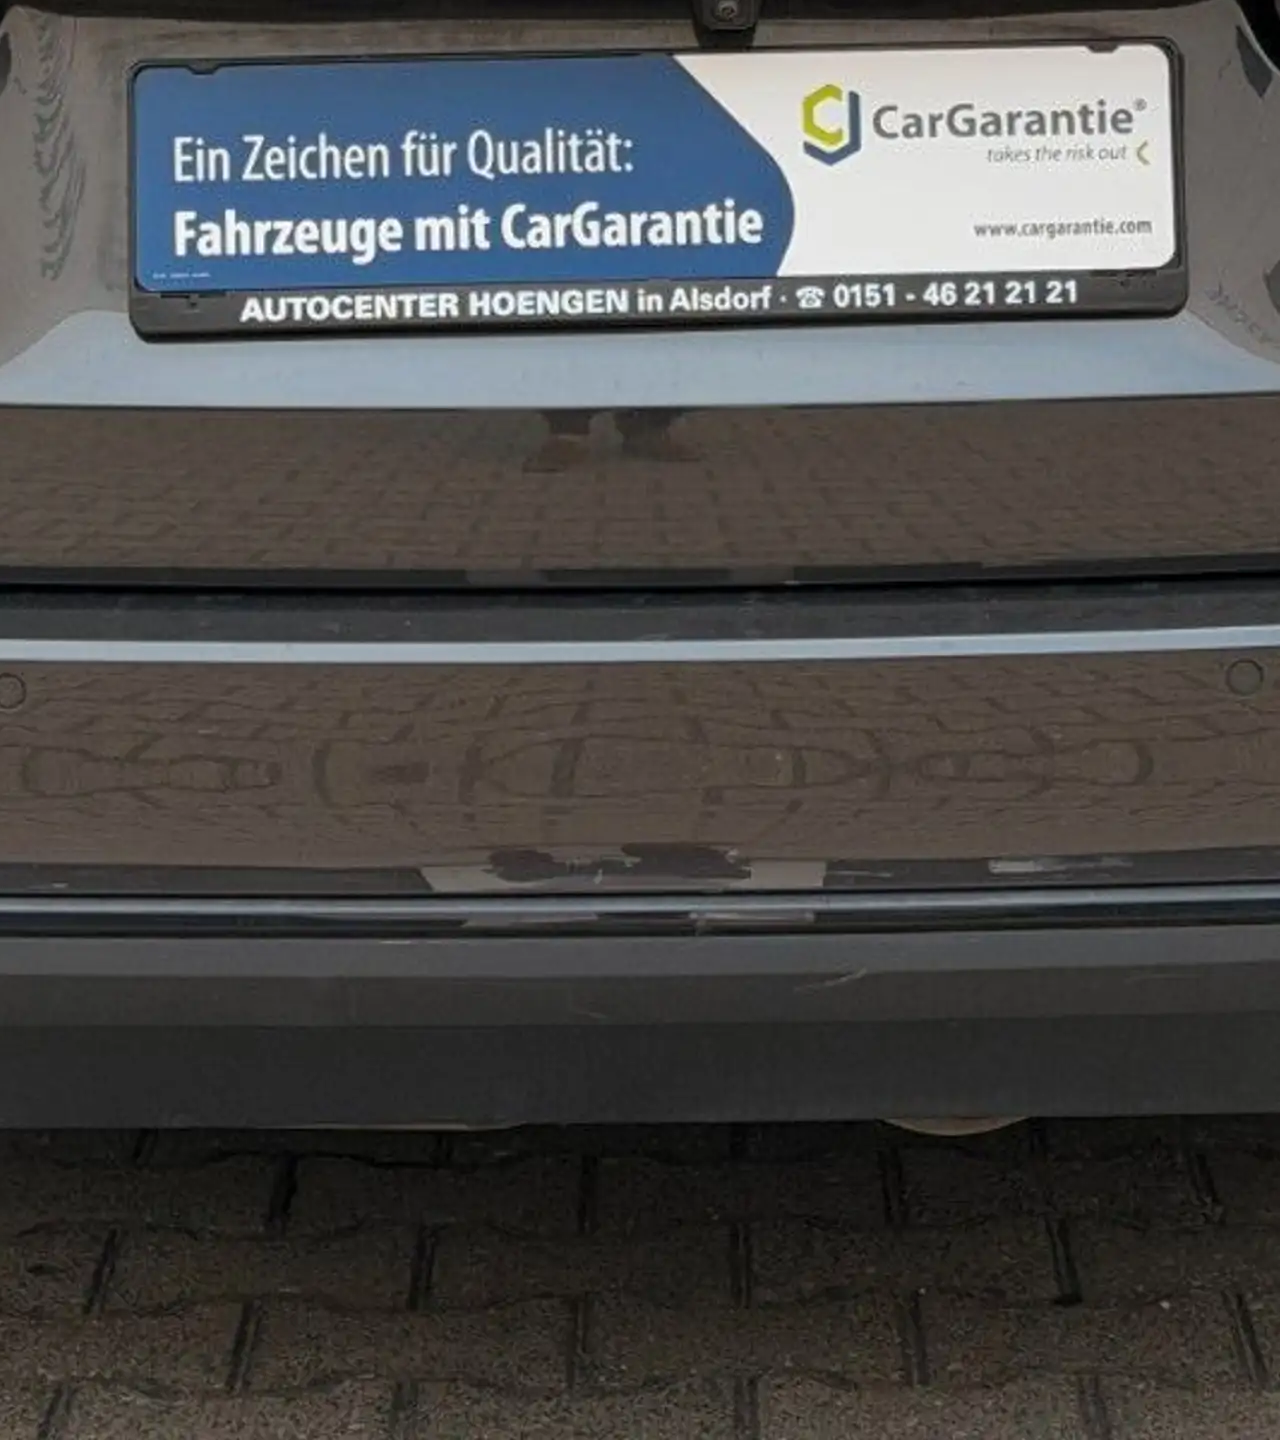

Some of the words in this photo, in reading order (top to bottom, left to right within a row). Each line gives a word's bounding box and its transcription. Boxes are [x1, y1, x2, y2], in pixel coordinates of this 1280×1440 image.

[174, 135, 231, 183] Ein
[242, 131, 390, 181] Zeichen
[401, 129, 457, 177] für
[467, 127, 634, 180] Qualität:
[987, 146, 1031, 163] takes
[1036, 145, 1062, 162] the
[1066, 144, 1095, 161] risk
[1099, 144, 1128, 161] out
[174, 208, 403, 265] Fahrzeuge
[414, 203, 491, 252] mit
[501, 198, 764, 249] CarGarantie
[974, 217, 1153, 240] www.cargarantie.com
[240, 292, 459, 323] AUTOCENTER
[469, 287, 628, 317] HOENGEN
[637, 288, 663, 313] in
[670, 284, 773, 311] Alsdorf
[834, 282, 896, 307] 0151
[923, 281, 956, 306] 46
[965, 280, 995, 305] 21
[1005, 279, 1036, 304] 21
[1045, 278, 1078, 304] 21
